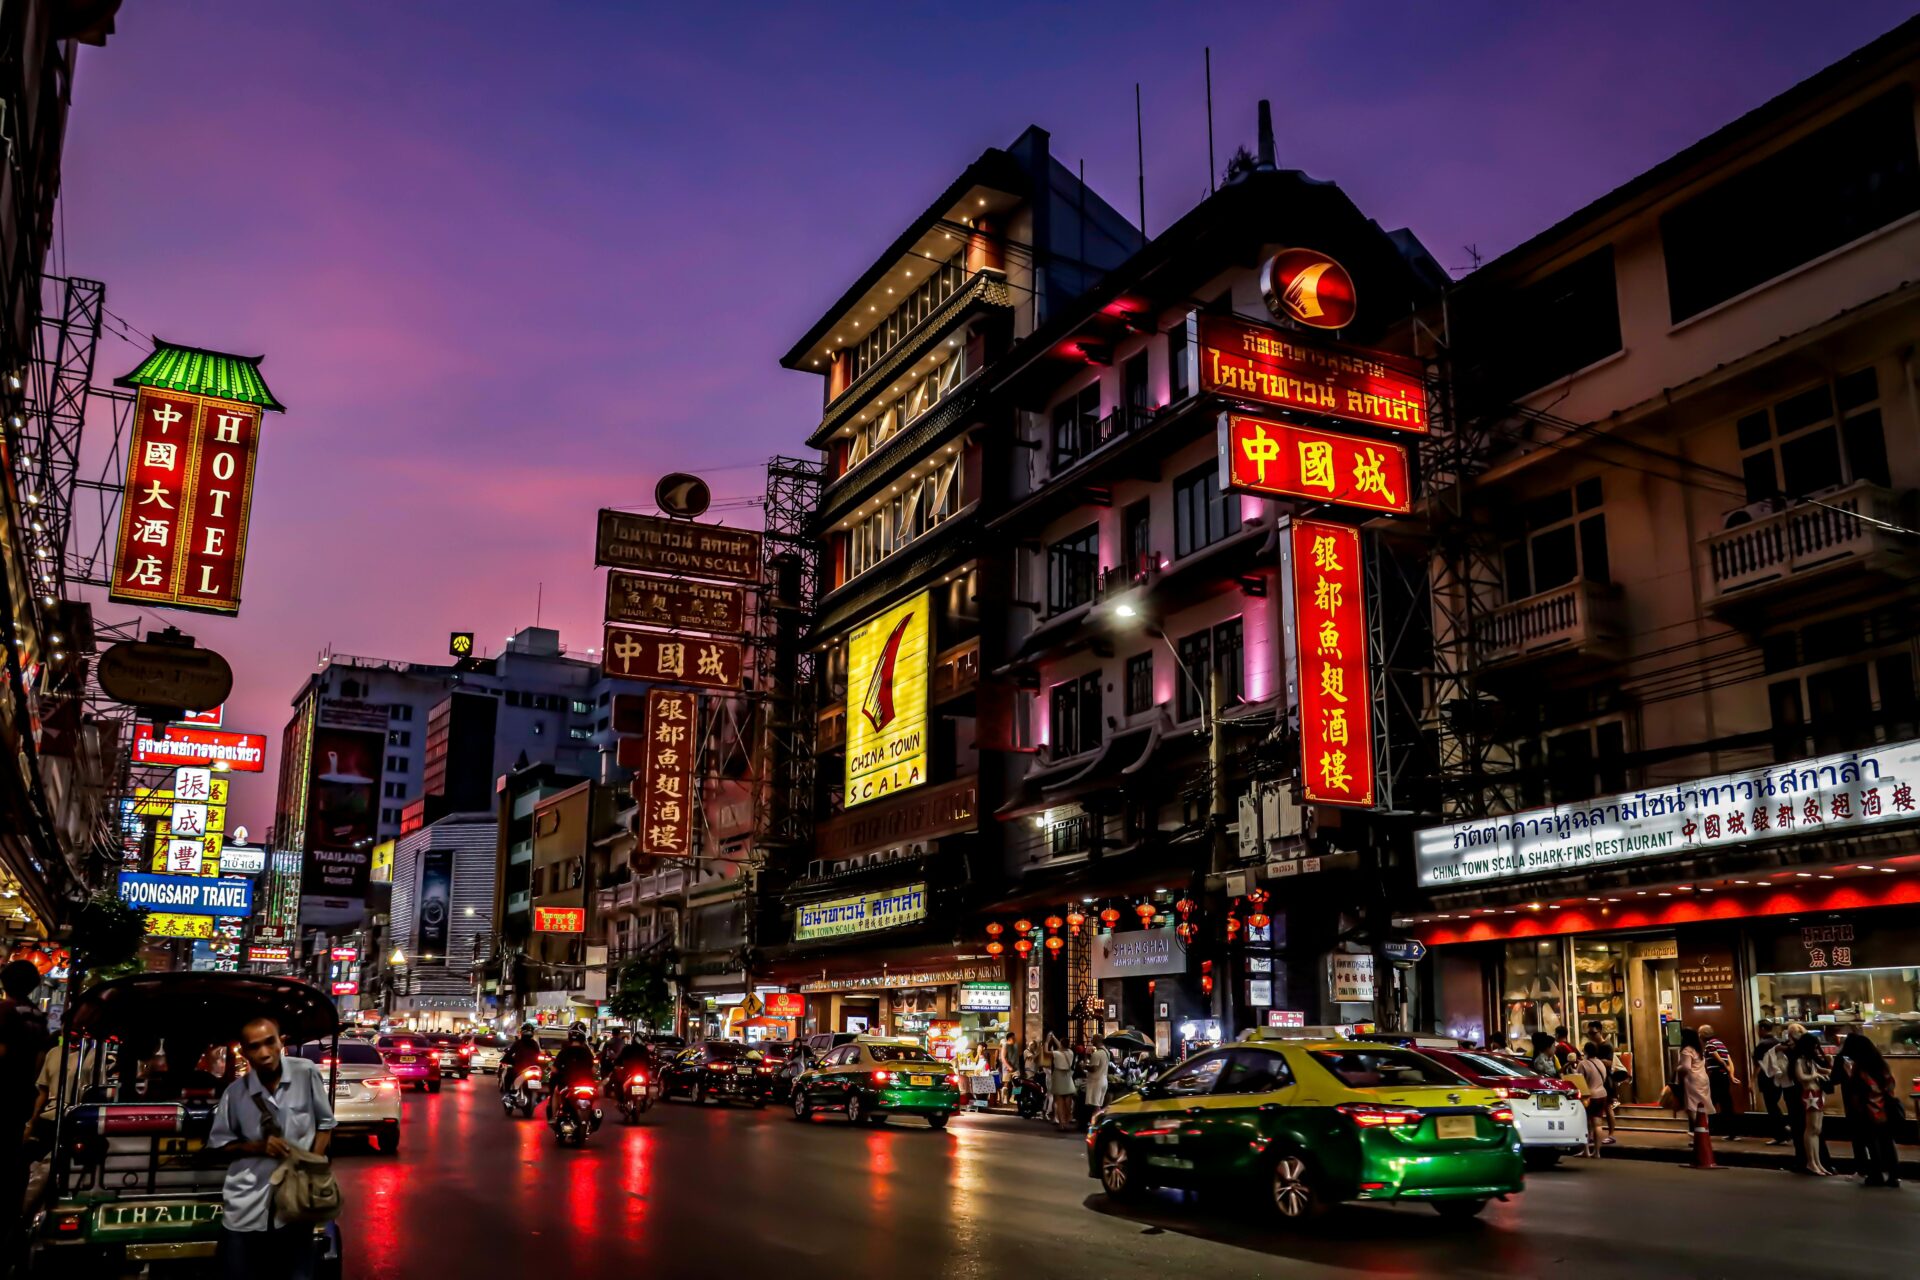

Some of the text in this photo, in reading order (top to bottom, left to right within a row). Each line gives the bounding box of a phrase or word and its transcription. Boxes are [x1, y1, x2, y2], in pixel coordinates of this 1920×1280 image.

[1208, 348, 1421, 424] ไชน่าทาวน์ สกาล่า
[1242, 425, 1395, 505] 中國城
[127, 403, 184, 586] 中國大酒店
[197, 415, 244, 594] HOTEL
[608, 543, 751, 575] CHINA TOWN SCALA
[613, 633, 729, 684] 中國城
[1311, 534, 1353, 794] 銀都魚翅酒樓
[648, 697, 688, 850] 銀都魚翅酒樓
[850, 731, 920, 773] CHINA TOWN
[850, 766, 919, 803] SCALA
[173, 772, 208, 871] 振成豐
[1432, 782, 1916, 880] CHINA TOWN SCALA SHARK-FINS RESTAURANT 中國城銀都魚翅酒樓
[121, 881, 248, 908] ROONGSARP TRAVEL
[799, 886, 922, 927] ไชน่าทาวน์ สกาล่า
[798, 927, 816, 939] CHINA
[816, 925, 835, 937] TOWN
[835, 922, 856, 935] SCALA
[1113, 939, 1169, 957] SHANGHAI
[964, 966, 1001, 980] RESAURNT
[1809, 946, 1852, 968] 魚翅
